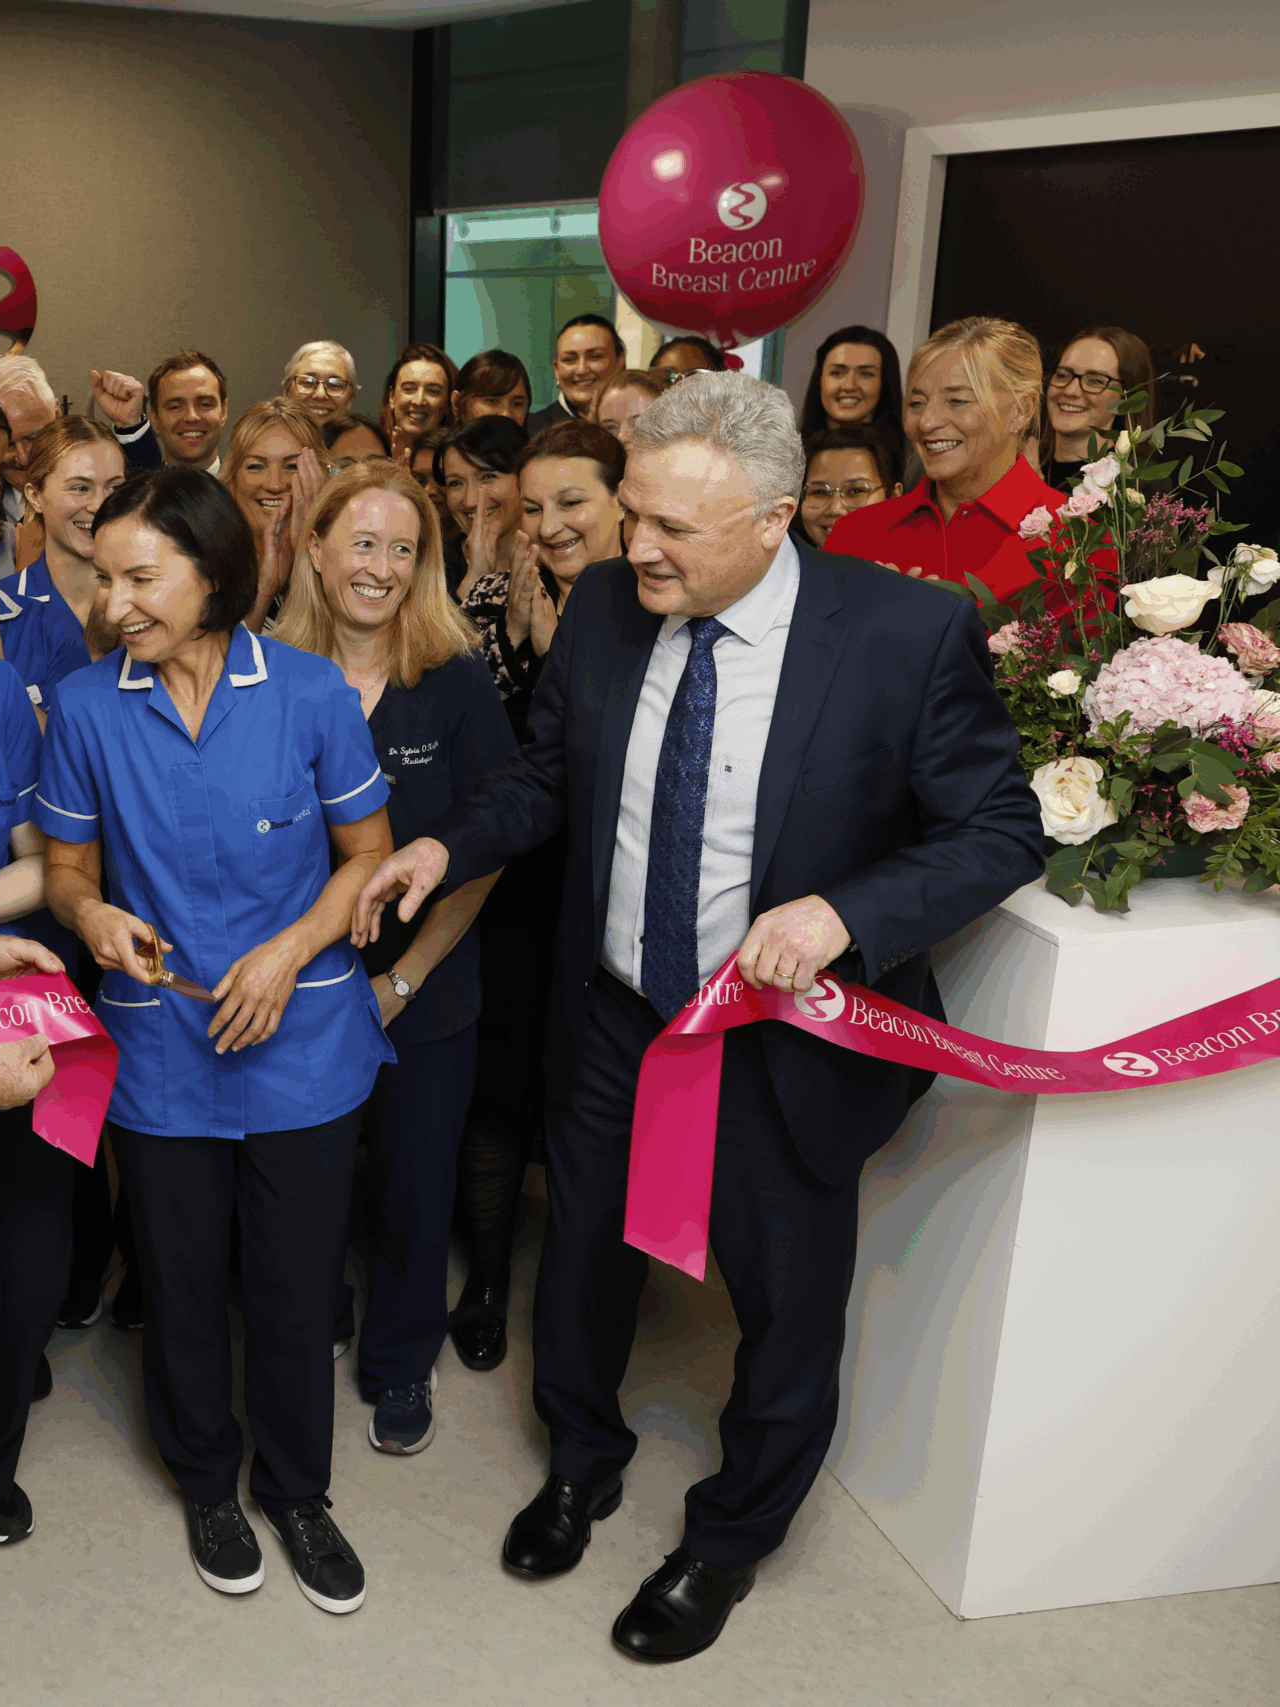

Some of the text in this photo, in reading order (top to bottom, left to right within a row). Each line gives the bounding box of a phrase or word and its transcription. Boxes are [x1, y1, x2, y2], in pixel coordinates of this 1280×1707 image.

[688, 237, 783, 264] Beacon
[651, 258, 818, 293] Breast Centre
[388, 747, 398, 756] Dr
[400, 746, 420, 756] Sylvia
[849, 996, 1066, 1081] Beacon Breast Centre
[1150, 1026, 1257, 1066] Beacon
